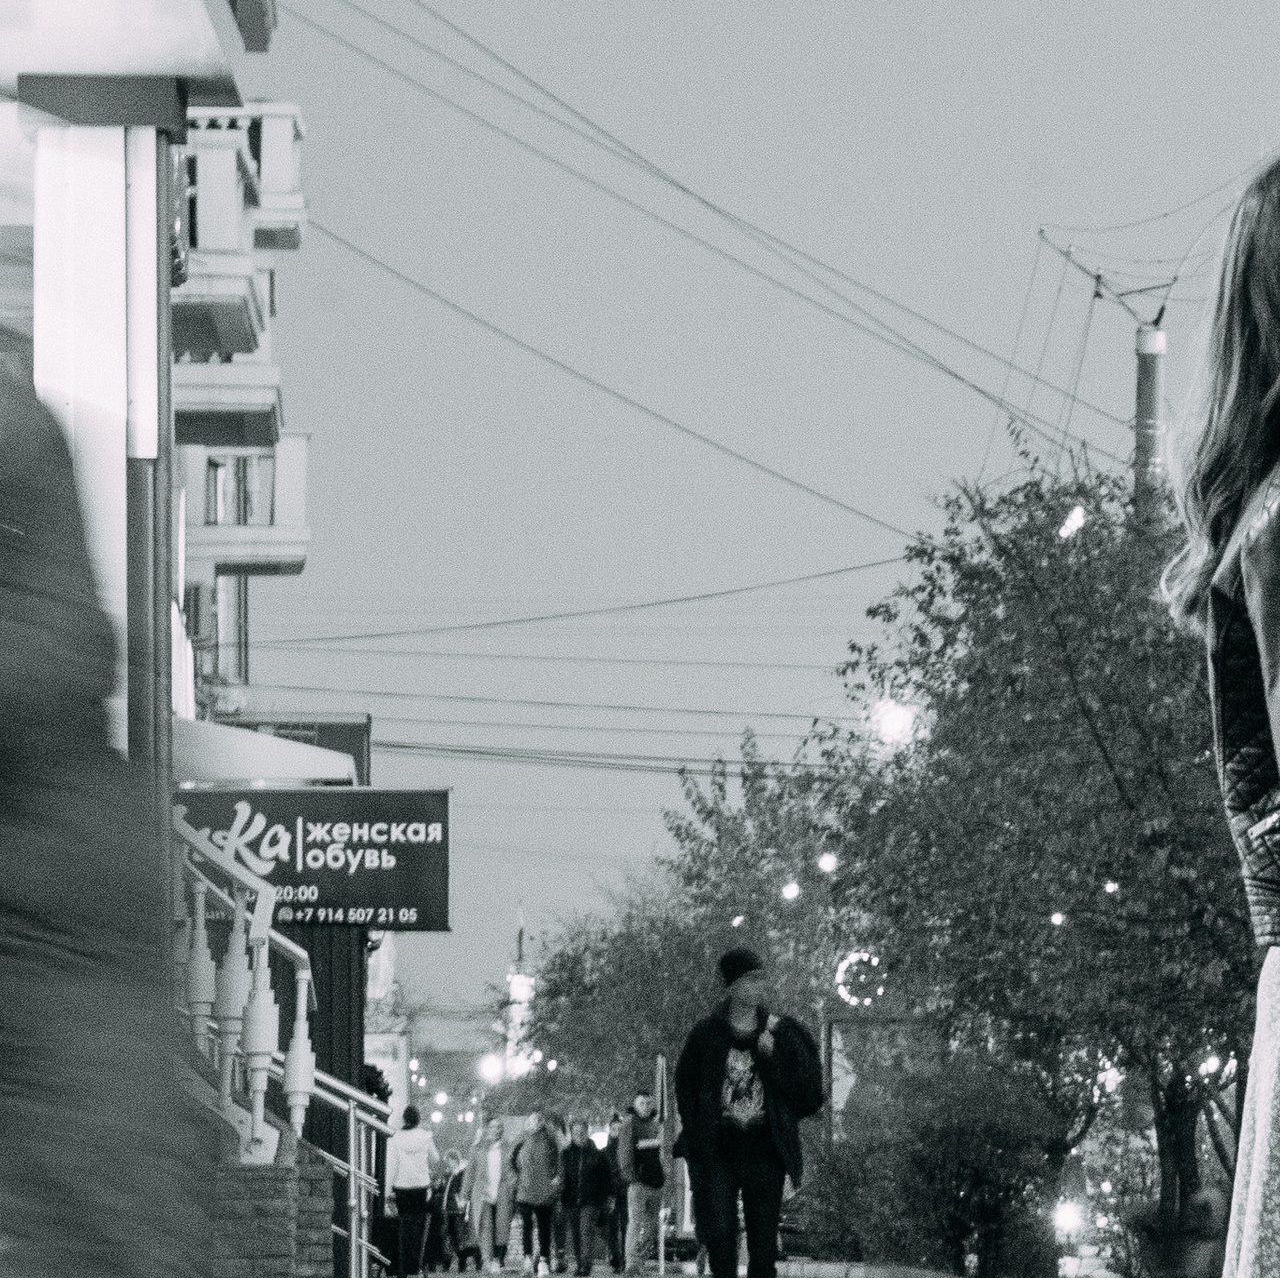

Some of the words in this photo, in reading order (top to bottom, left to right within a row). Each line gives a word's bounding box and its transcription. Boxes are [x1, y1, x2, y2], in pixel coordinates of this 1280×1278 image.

[306, 822, 443, 844] женская
[305, 842, 397, 876] обувь
[295, 907, 314, 922] +7
[317, 907, 344, 923] 914
[348, 907, 375, 923] 507
[377, 907, 395, 923] 21
